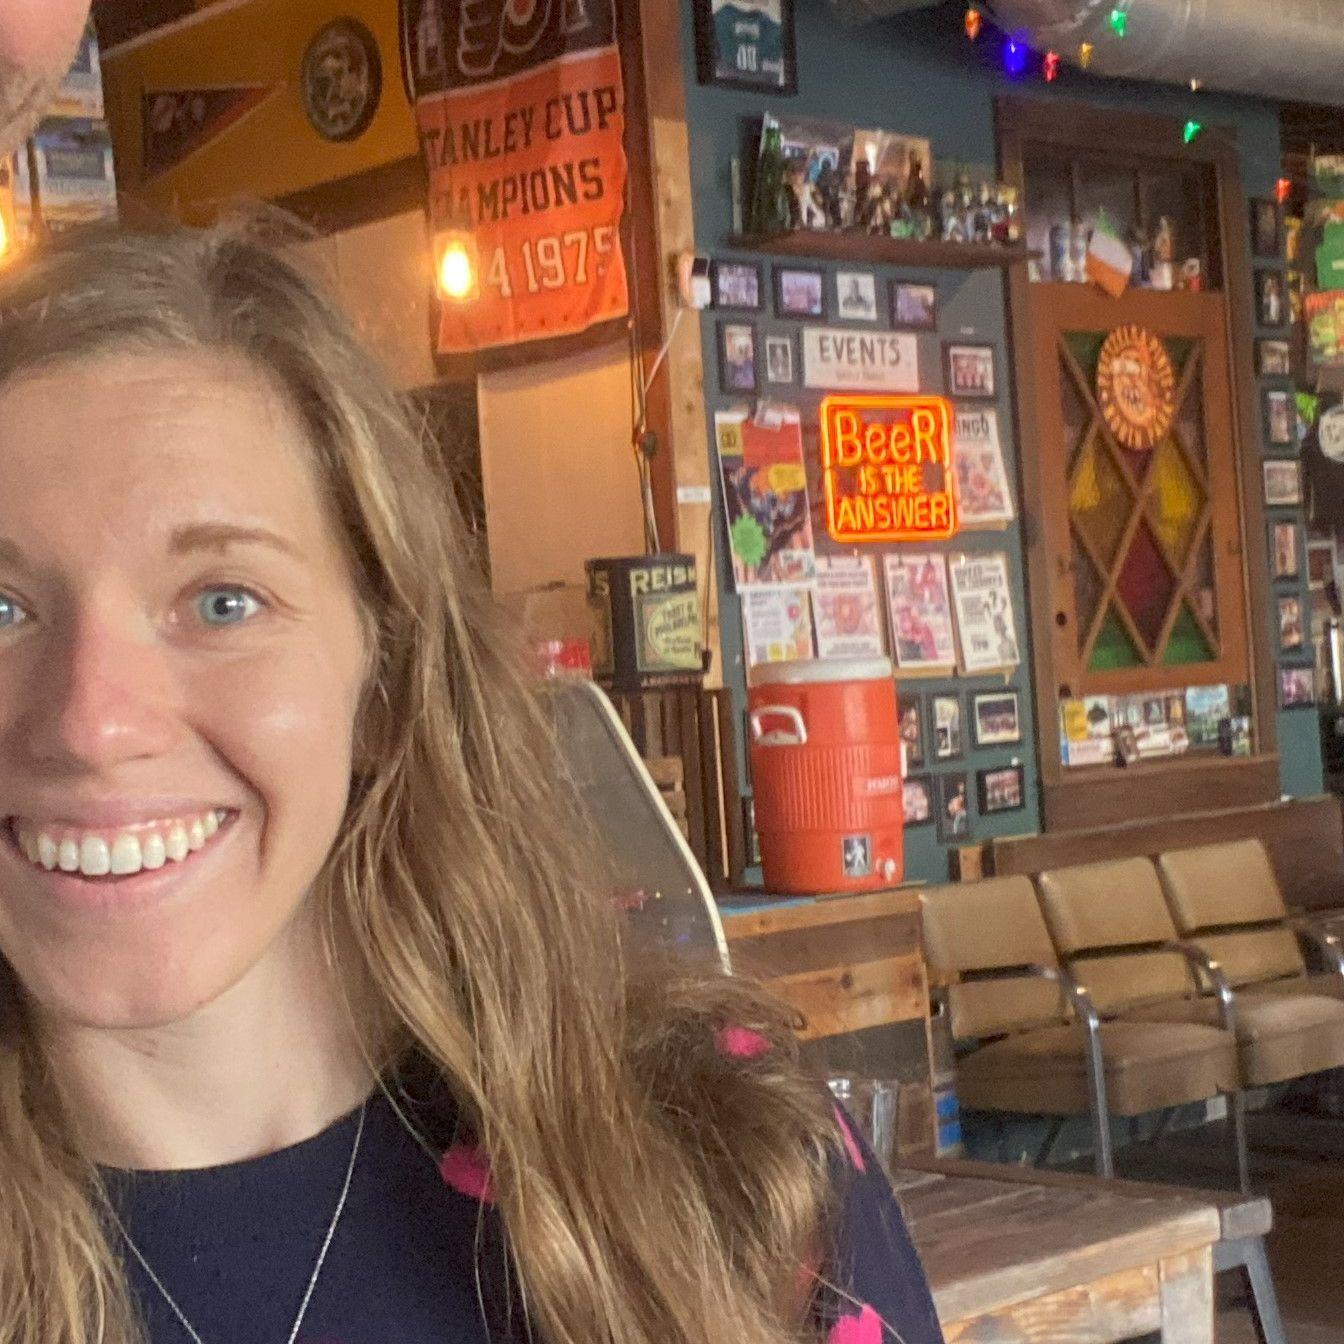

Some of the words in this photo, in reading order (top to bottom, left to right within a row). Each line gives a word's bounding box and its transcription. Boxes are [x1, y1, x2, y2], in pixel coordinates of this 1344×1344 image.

[419, 107, 534, 168] TANLEY
[543, 85, 617, 141] CUP
[818, 334, 902, 367] EVENTS
[859, 464, 879, 494] IS
[881, 464, 923, 494] THE
[836, 492, 950, 532] ANSWER
